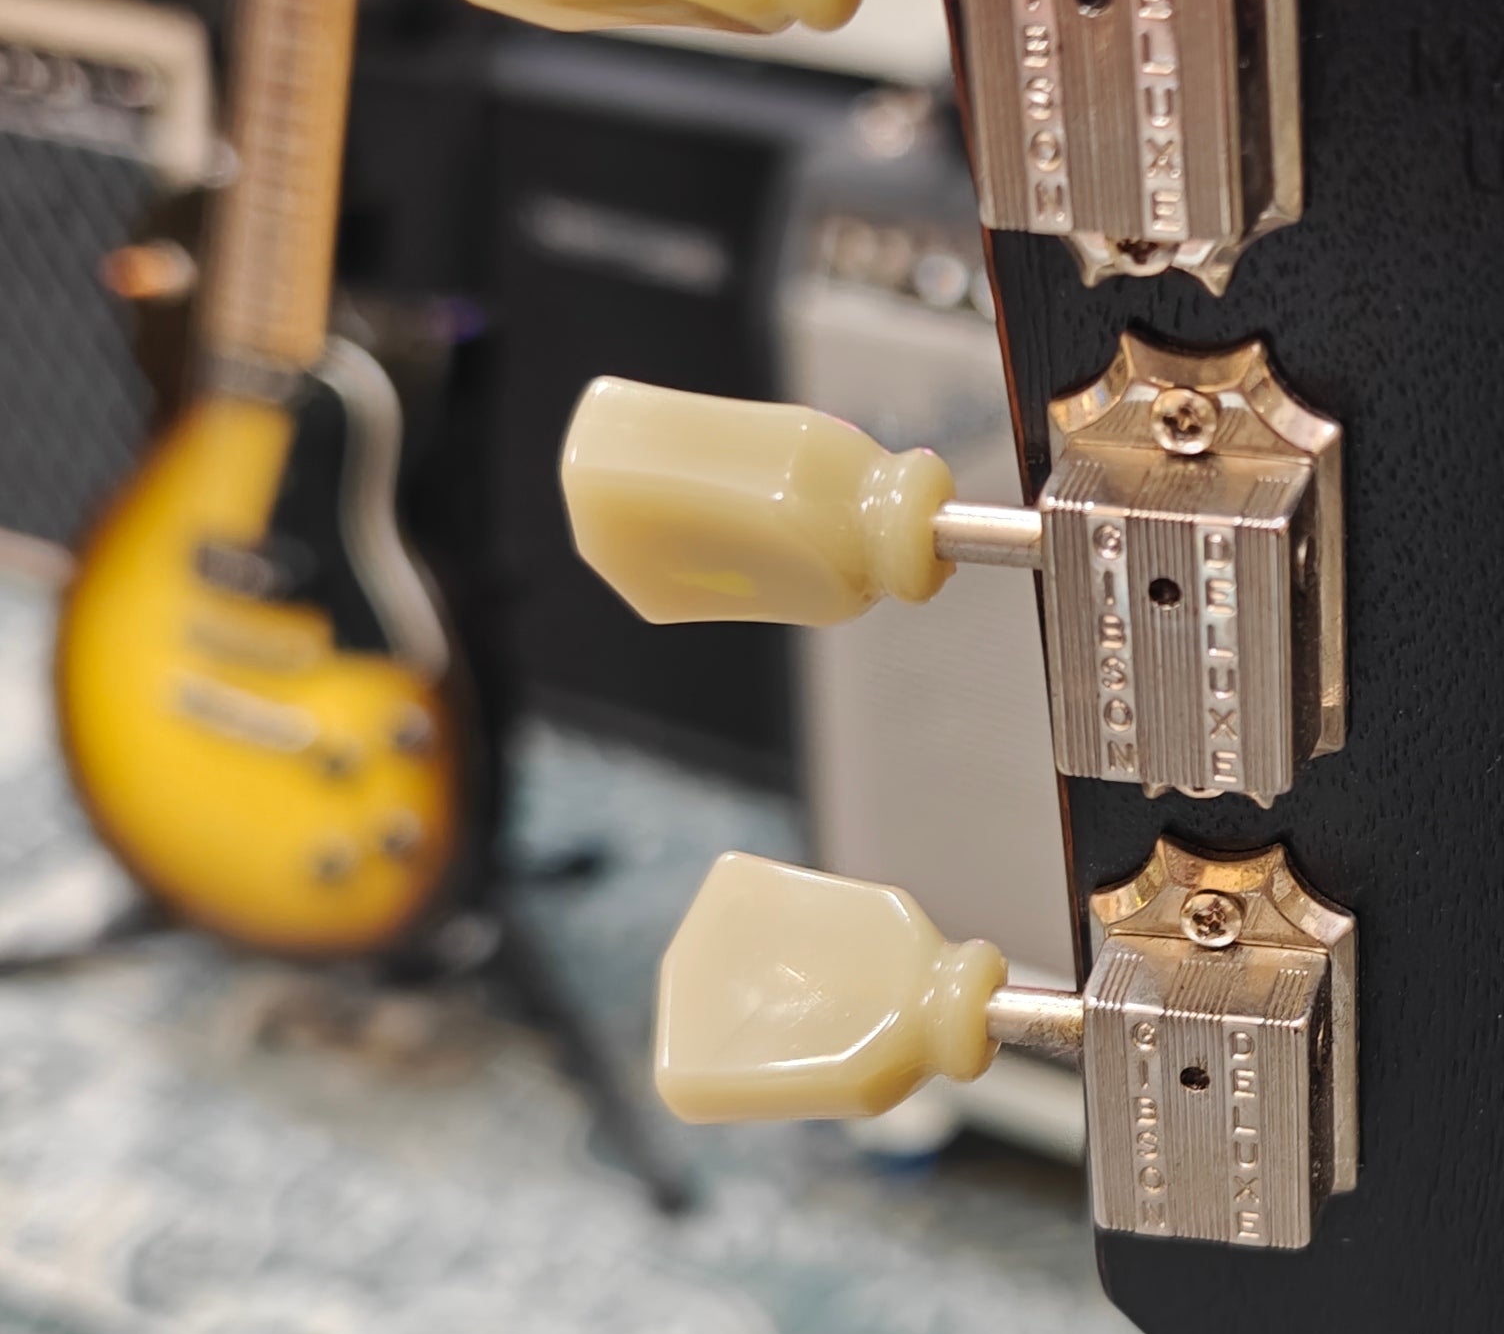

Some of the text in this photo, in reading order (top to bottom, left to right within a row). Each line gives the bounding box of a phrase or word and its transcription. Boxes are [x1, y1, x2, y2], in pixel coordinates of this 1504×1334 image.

[1092, 523, 1136, 774] GIBSON
[1203, 531, 1240, 784] DELUXE
[1132, 1020, 1167, 1230] GIBSON
[1228, 1030, 1261, 1240] DELUXE
